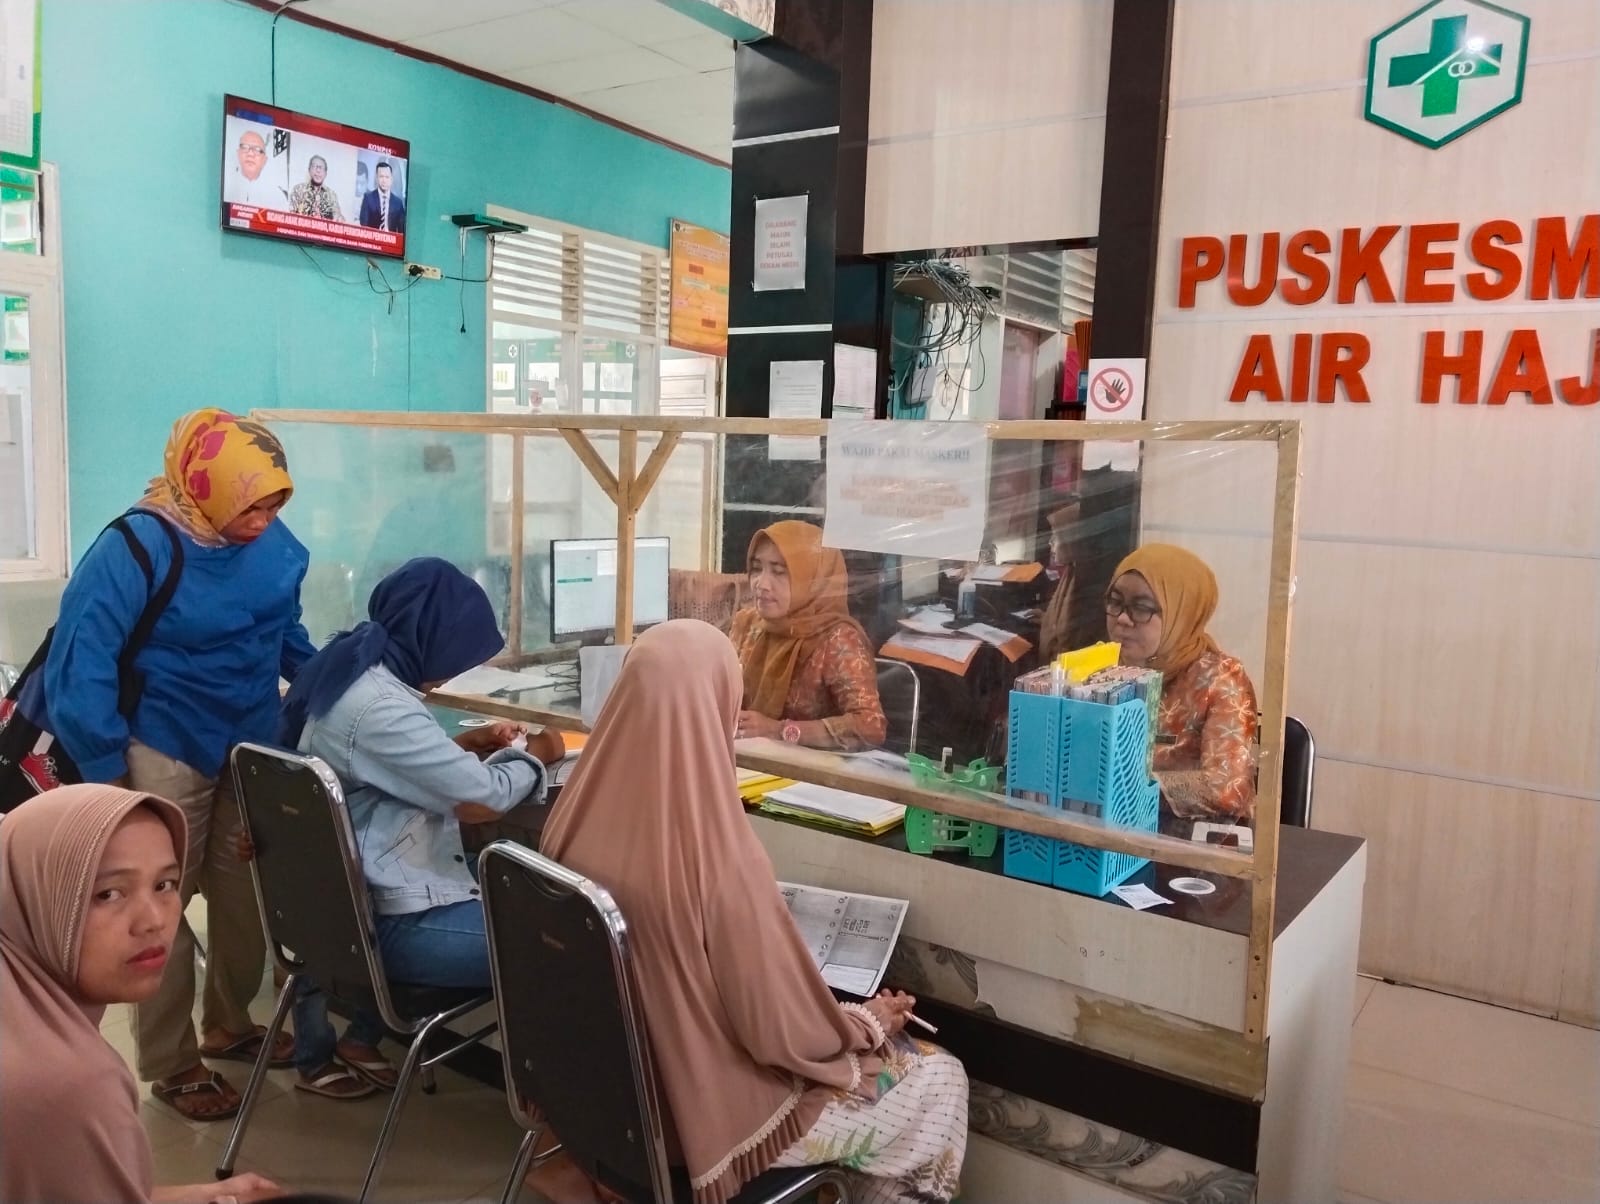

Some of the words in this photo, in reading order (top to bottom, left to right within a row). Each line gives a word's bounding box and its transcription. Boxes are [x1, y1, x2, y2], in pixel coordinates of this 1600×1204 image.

[1178, 214, 1600, 309] PUSKESM
[1229, 332, 1371, 403] AIR
[1420, 328, 1600, 405] HAJ
